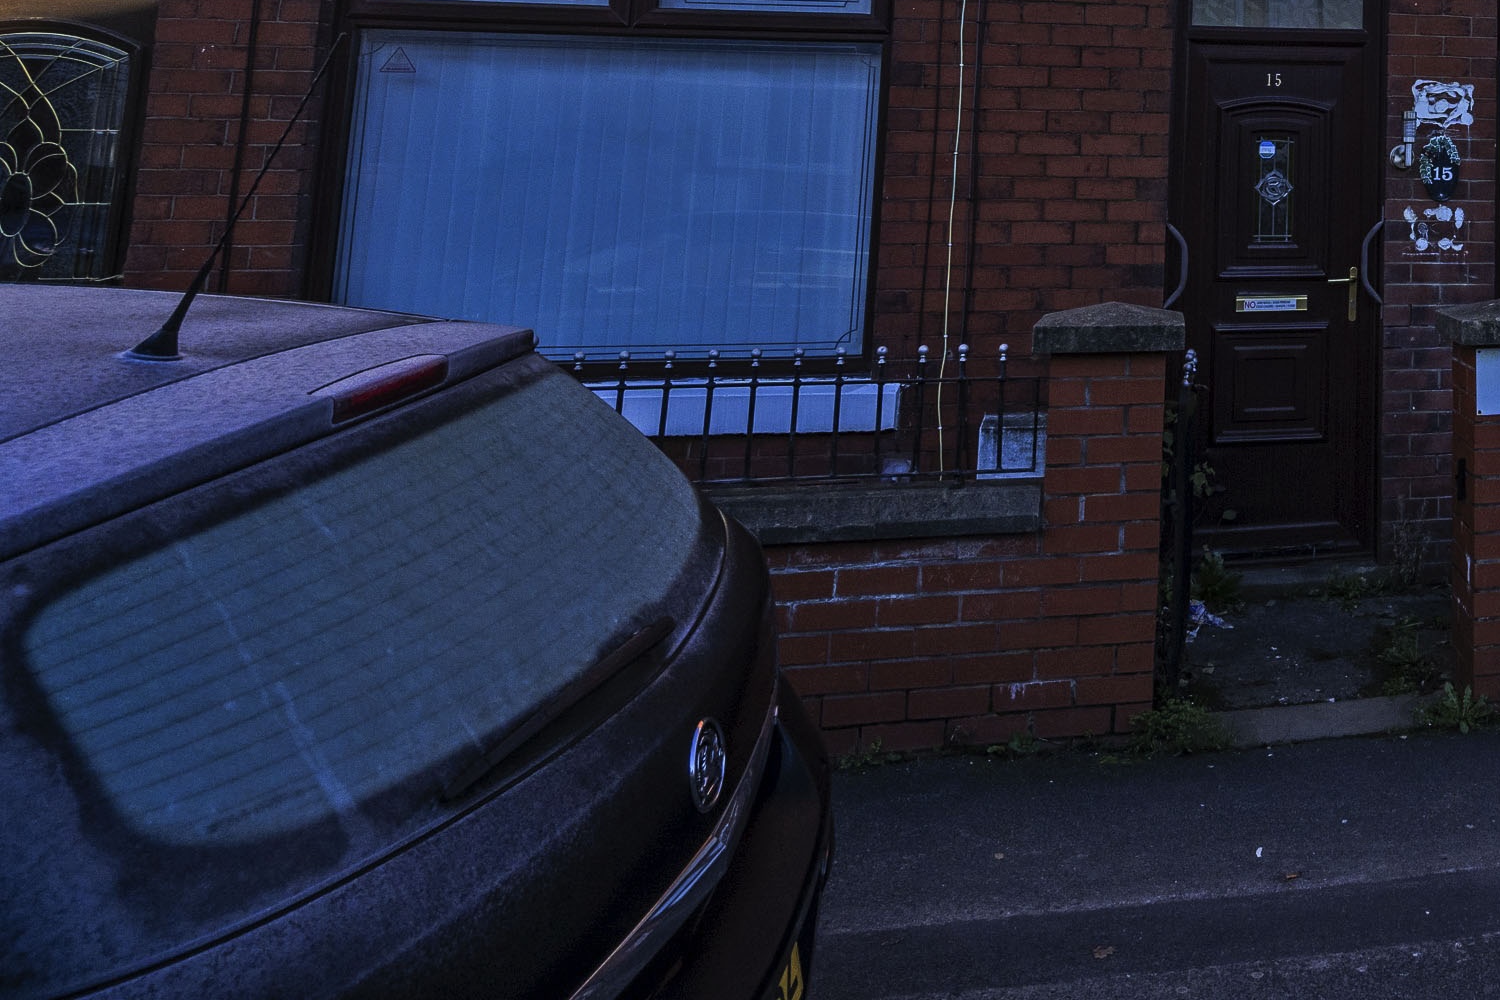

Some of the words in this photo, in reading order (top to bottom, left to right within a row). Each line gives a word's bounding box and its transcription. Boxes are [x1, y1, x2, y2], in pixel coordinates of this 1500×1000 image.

[1266, 73, 1282, 87] 15
[1433, 166, 1453, 181] 15
[1244, 300, 1256, 309] NO
